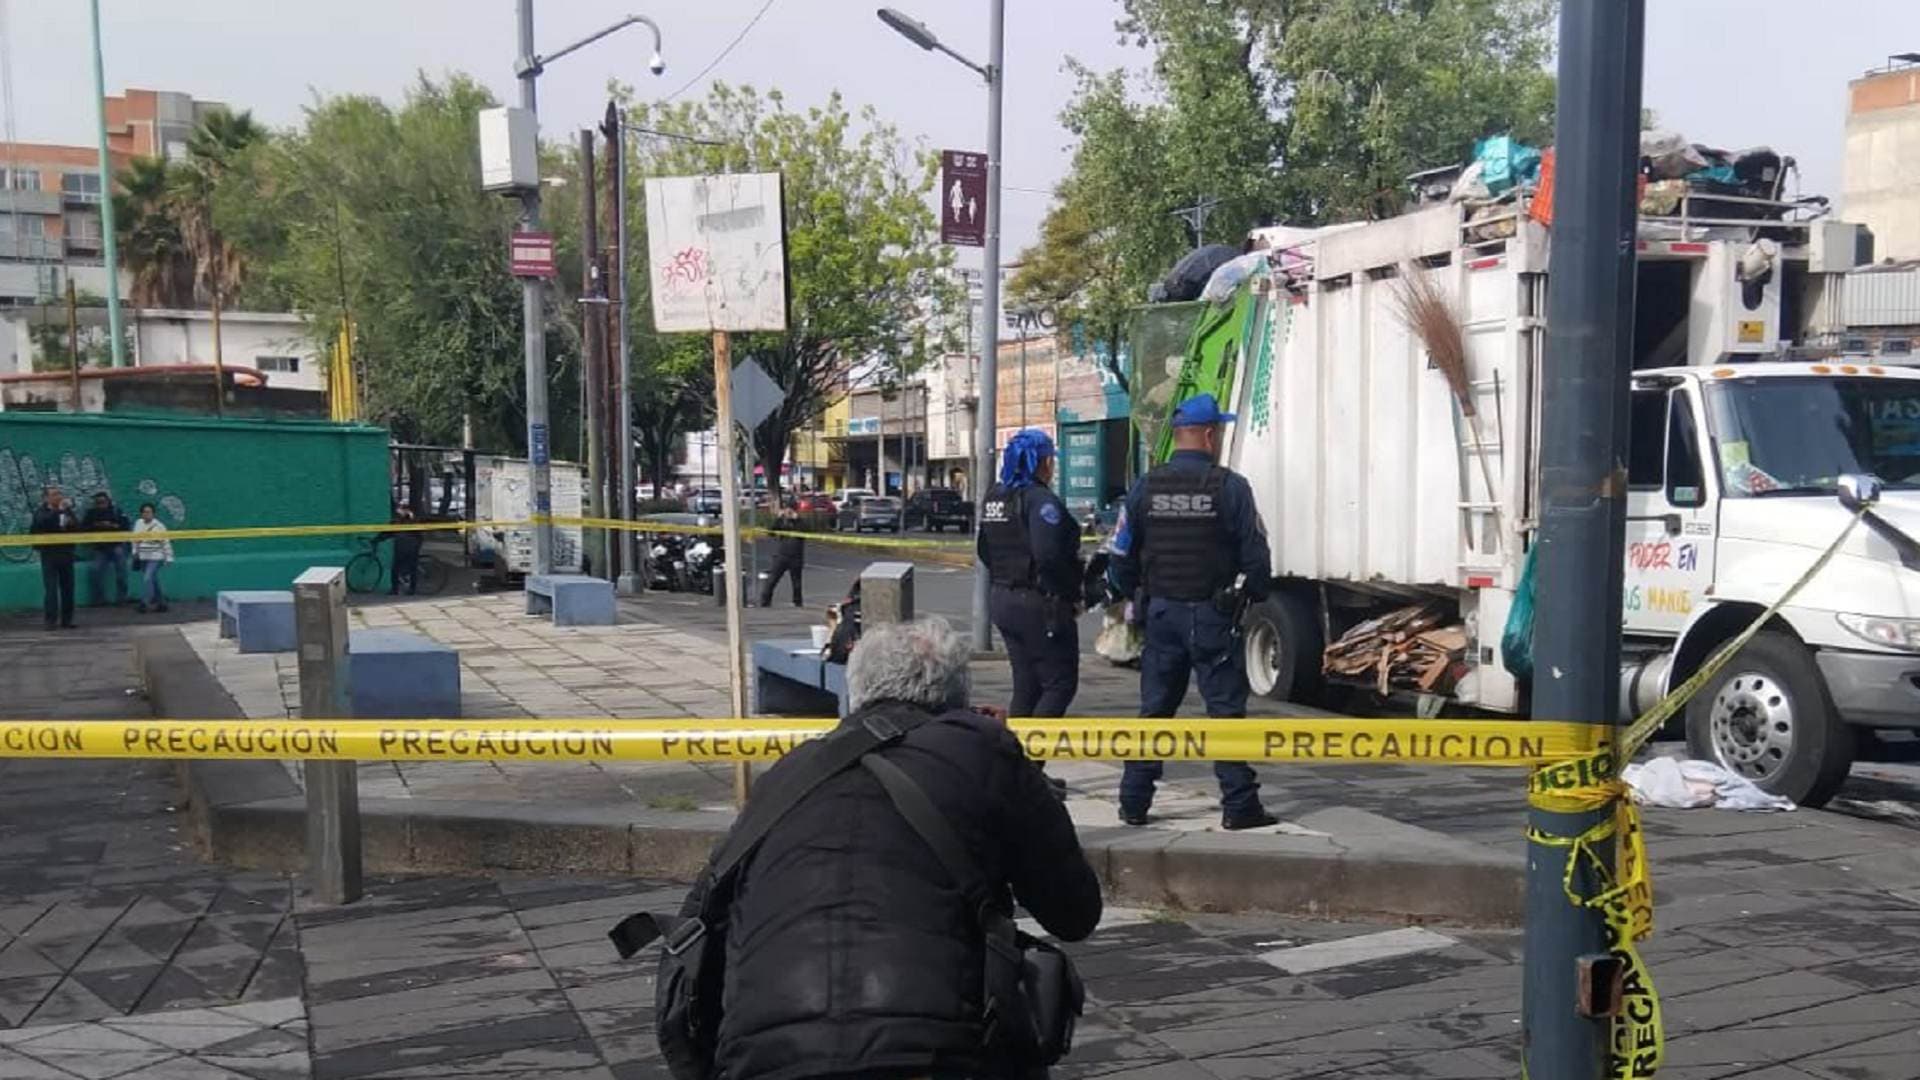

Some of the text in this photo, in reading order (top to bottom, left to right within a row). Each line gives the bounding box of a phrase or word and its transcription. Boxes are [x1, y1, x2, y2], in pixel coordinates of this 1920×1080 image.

[985, 501, 1005, 517] SSC
[1151, 494, 1213, 511] SSC
[1678, 543, 1698, 571] EN
[124, 728, 339, 753] PRECAUCION
[379, 729, 613, 755] PRECAUCION
[1264, 731, 1544, 758] PRECAUCION
